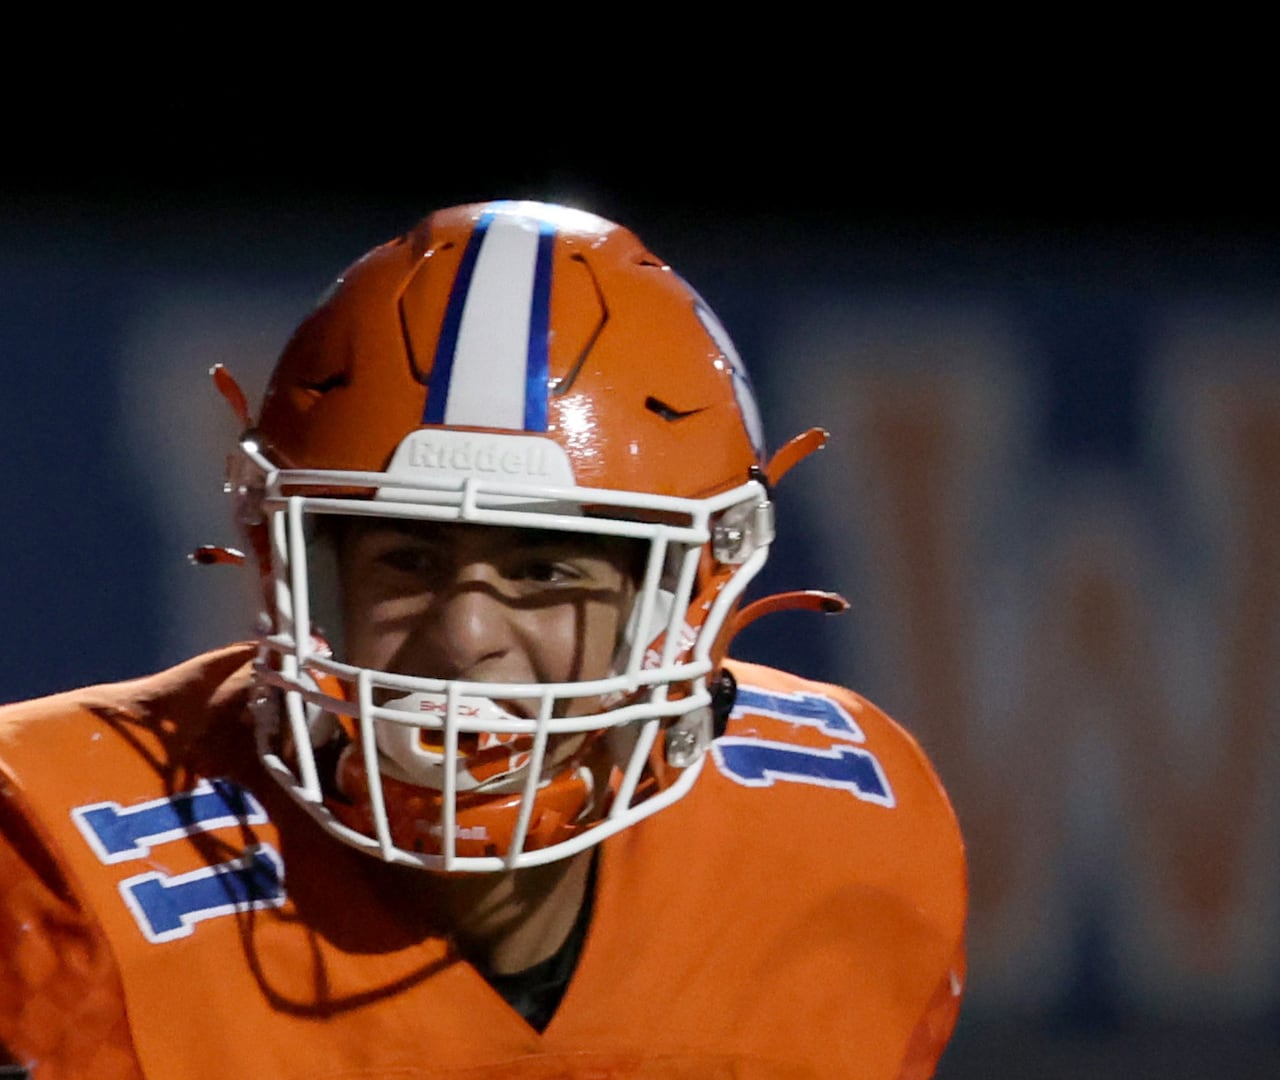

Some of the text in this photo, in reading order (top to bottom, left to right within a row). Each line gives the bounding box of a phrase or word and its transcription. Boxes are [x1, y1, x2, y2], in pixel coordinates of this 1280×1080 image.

[407, 436, 553, 477] Riddell
[419, 700, 481, 717] SHCK
[709, 684, 896, 809] 11
[69, 775, 287, 944] 11
